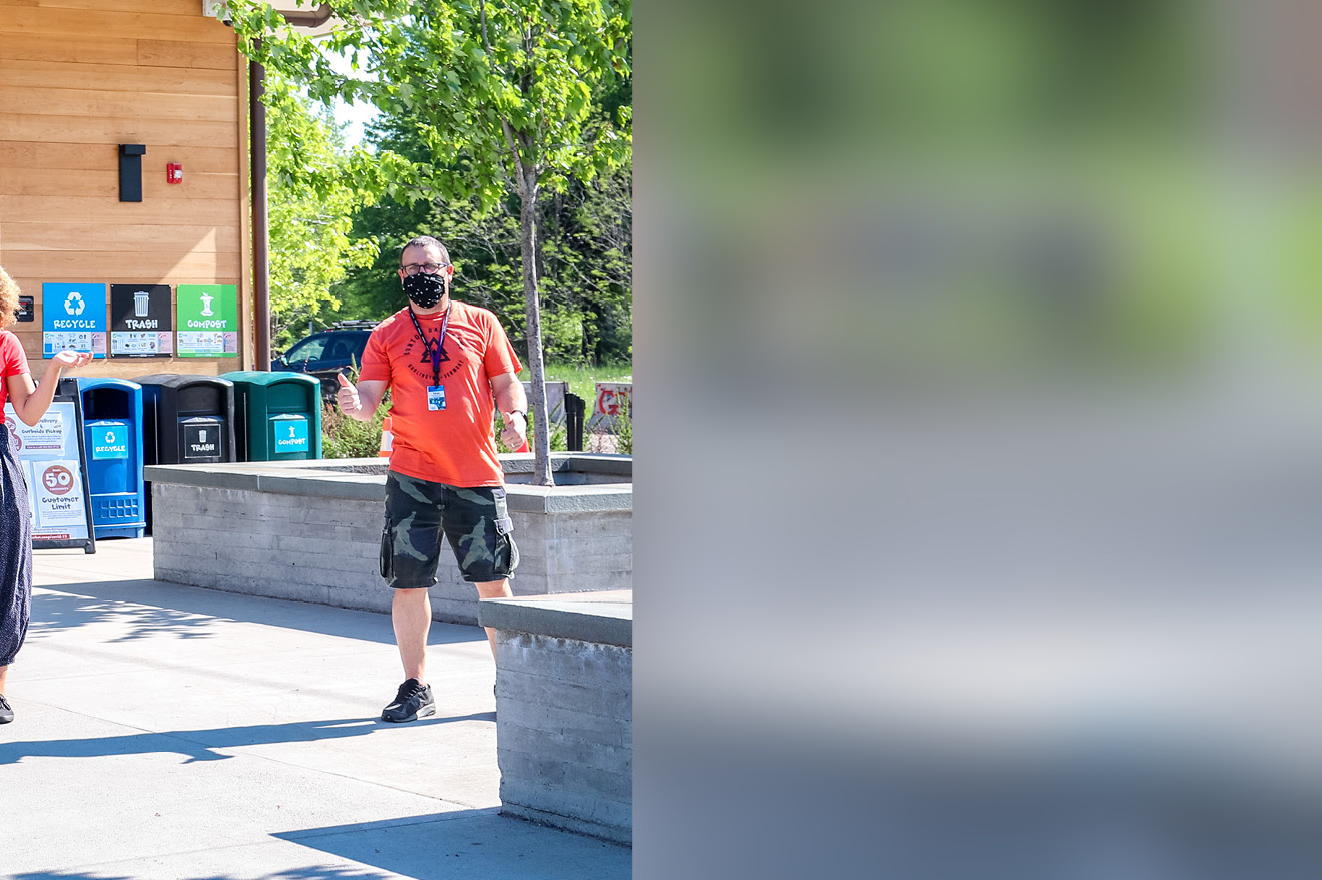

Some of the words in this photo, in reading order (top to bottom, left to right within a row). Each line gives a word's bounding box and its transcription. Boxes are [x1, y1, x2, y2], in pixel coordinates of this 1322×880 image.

[53, 320, 96, 329] RECYCLE
[125, 319, 158, 330] TRASH
[187, 320, 227, 329] COMPOST
[95, 445, 126, 453] RECYCLE
[191, 444, 215, 452] TRASH
[45, 472, 71, 487] 50
[42, 496, 79, 504] Customer
[52, 502, 72, 510] Limit
